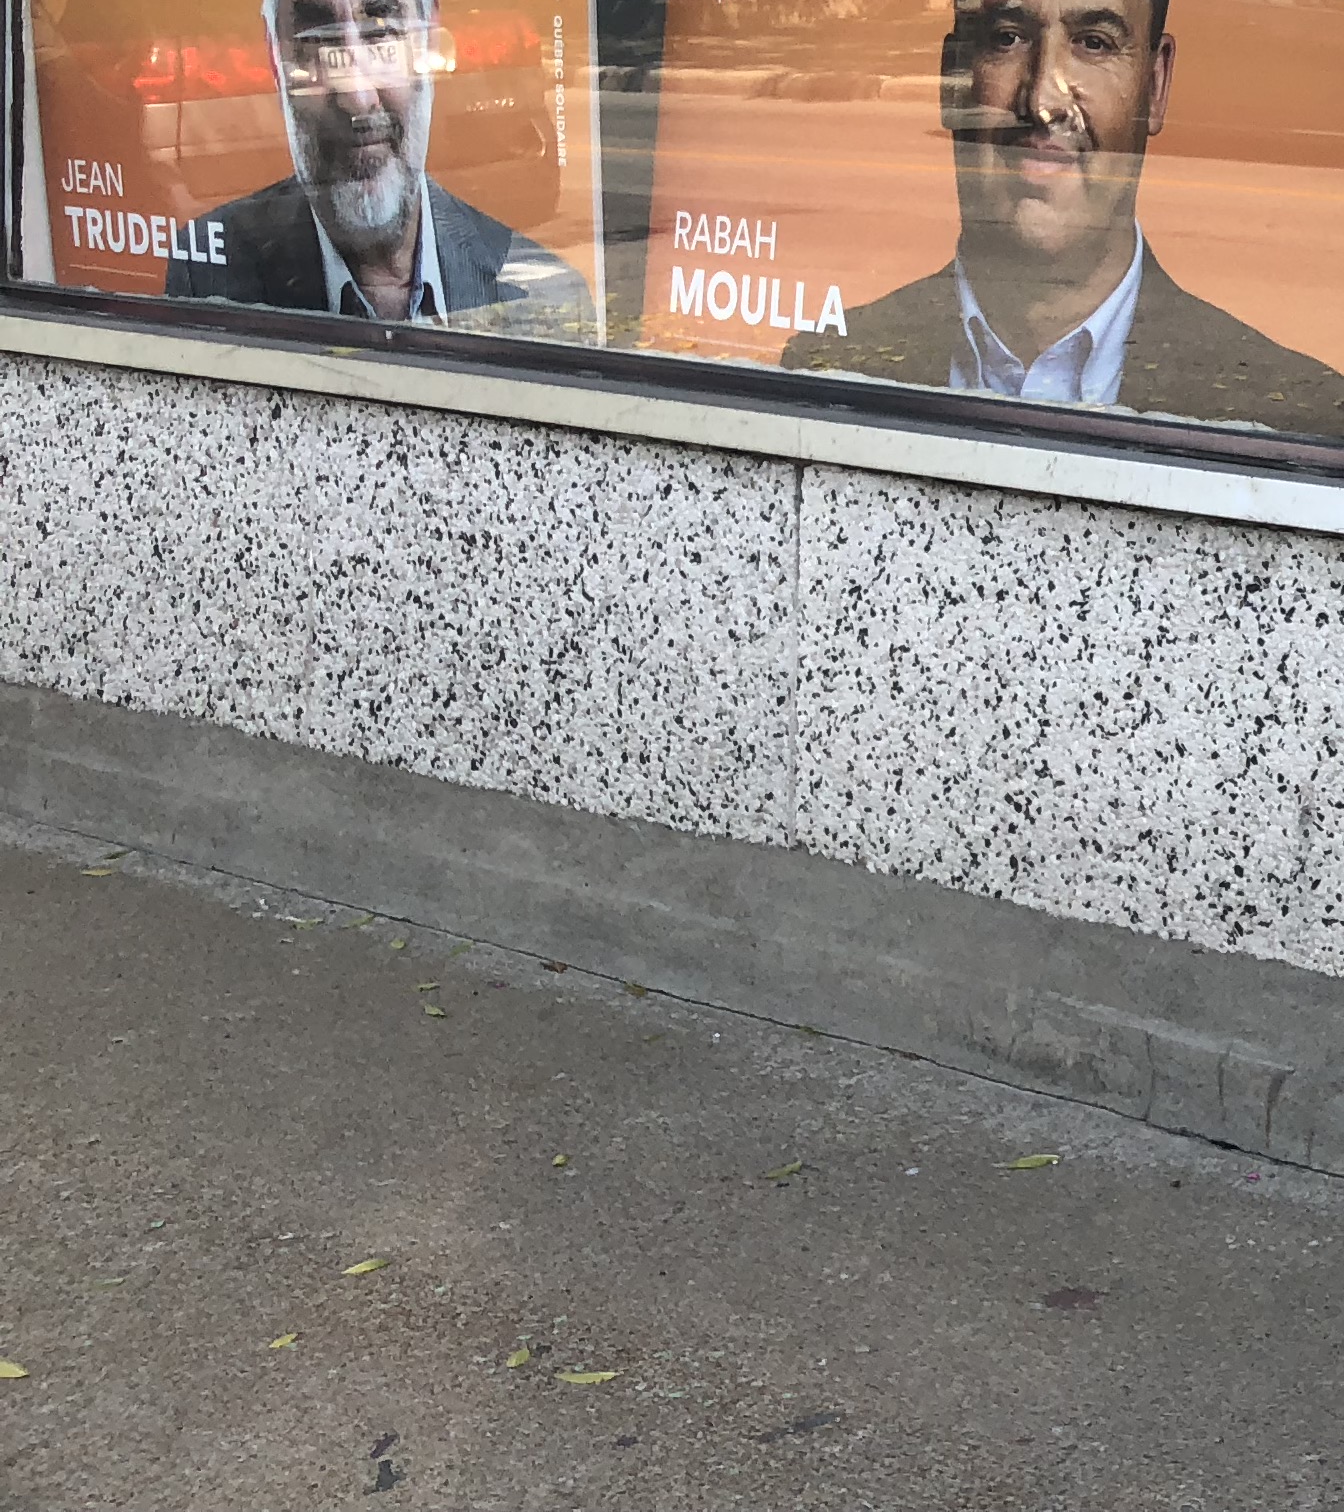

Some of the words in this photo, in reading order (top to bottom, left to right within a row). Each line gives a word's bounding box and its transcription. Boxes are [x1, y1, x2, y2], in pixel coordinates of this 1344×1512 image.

[555, 84, 567, 167] SOLIDAIRE
[61, 158, 124, 197] JEAN
[64, 205, 227, 266] TRUDELLE
[674, 210, 777, 260] RABAH
[670, 265, 847, 337] MOULLA
